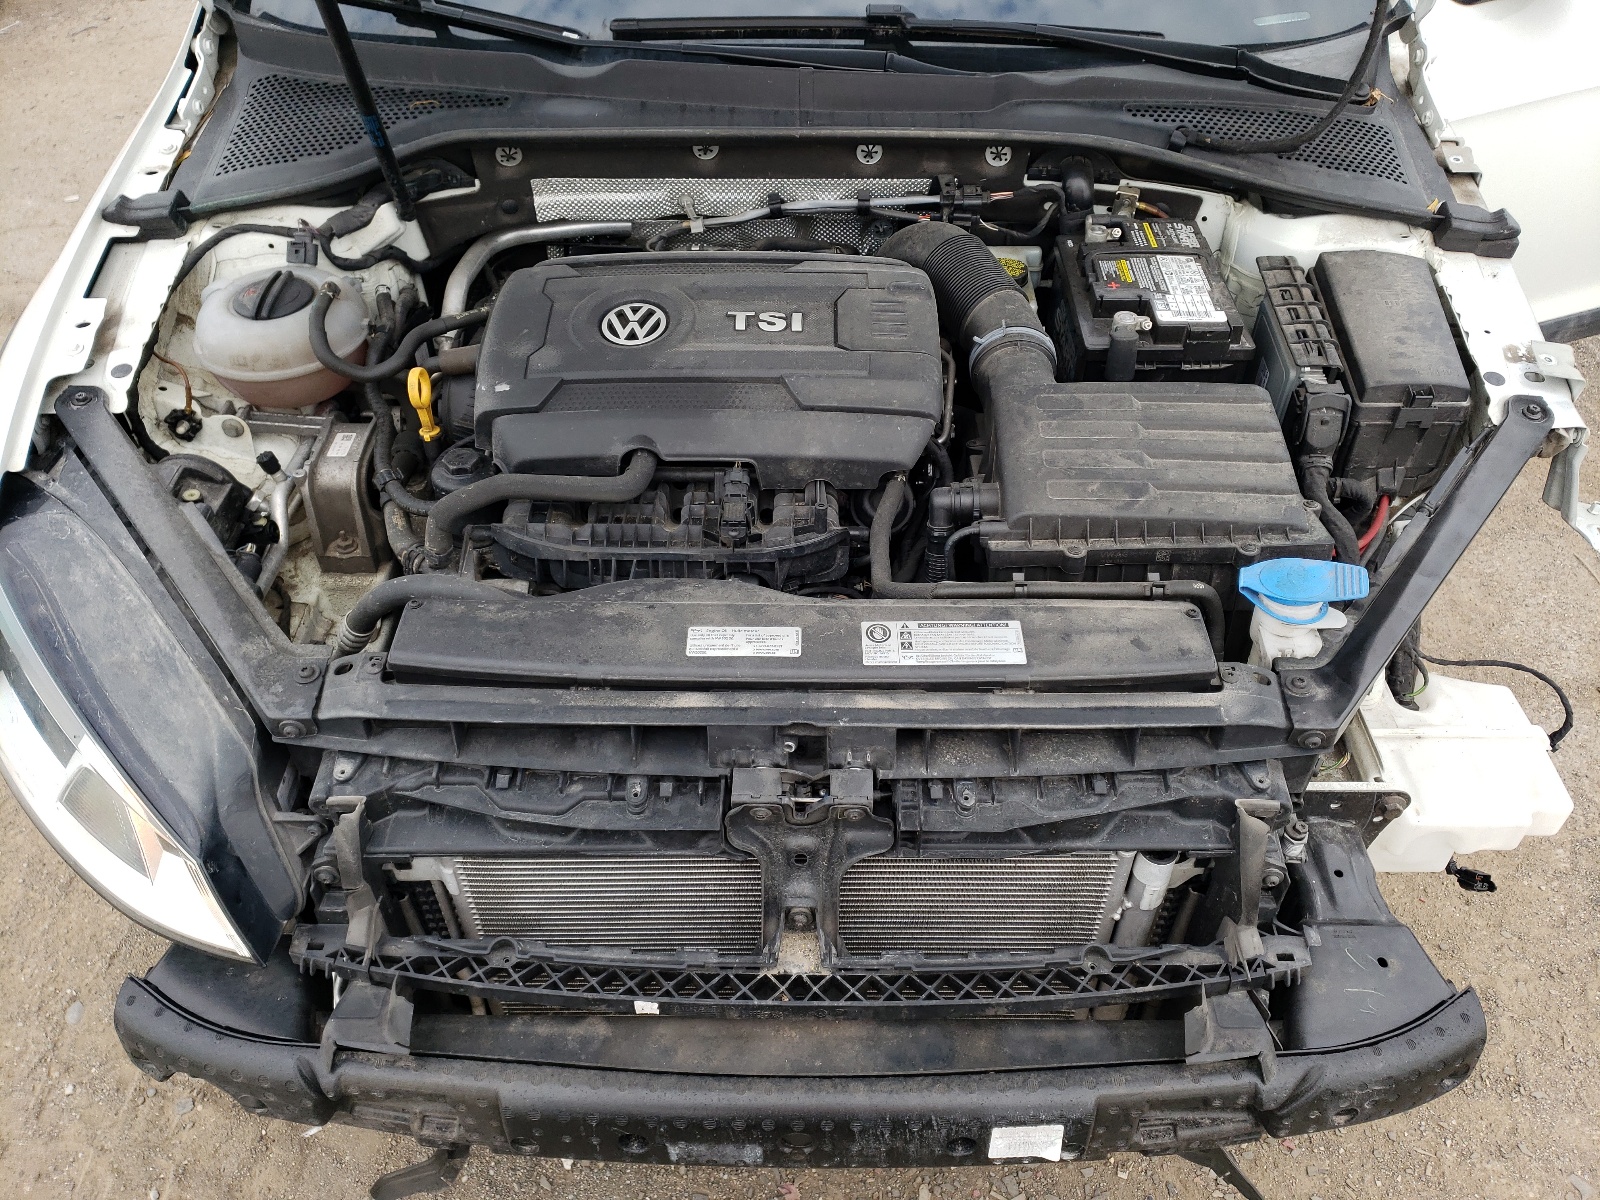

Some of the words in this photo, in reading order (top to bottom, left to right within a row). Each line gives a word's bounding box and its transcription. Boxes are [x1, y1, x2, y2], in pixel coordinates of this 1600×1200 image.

[1173, 222, 1190, 247] START
[1186, 224, 1200, 248] SUPER
[727, 311, 803, 332] TSI
